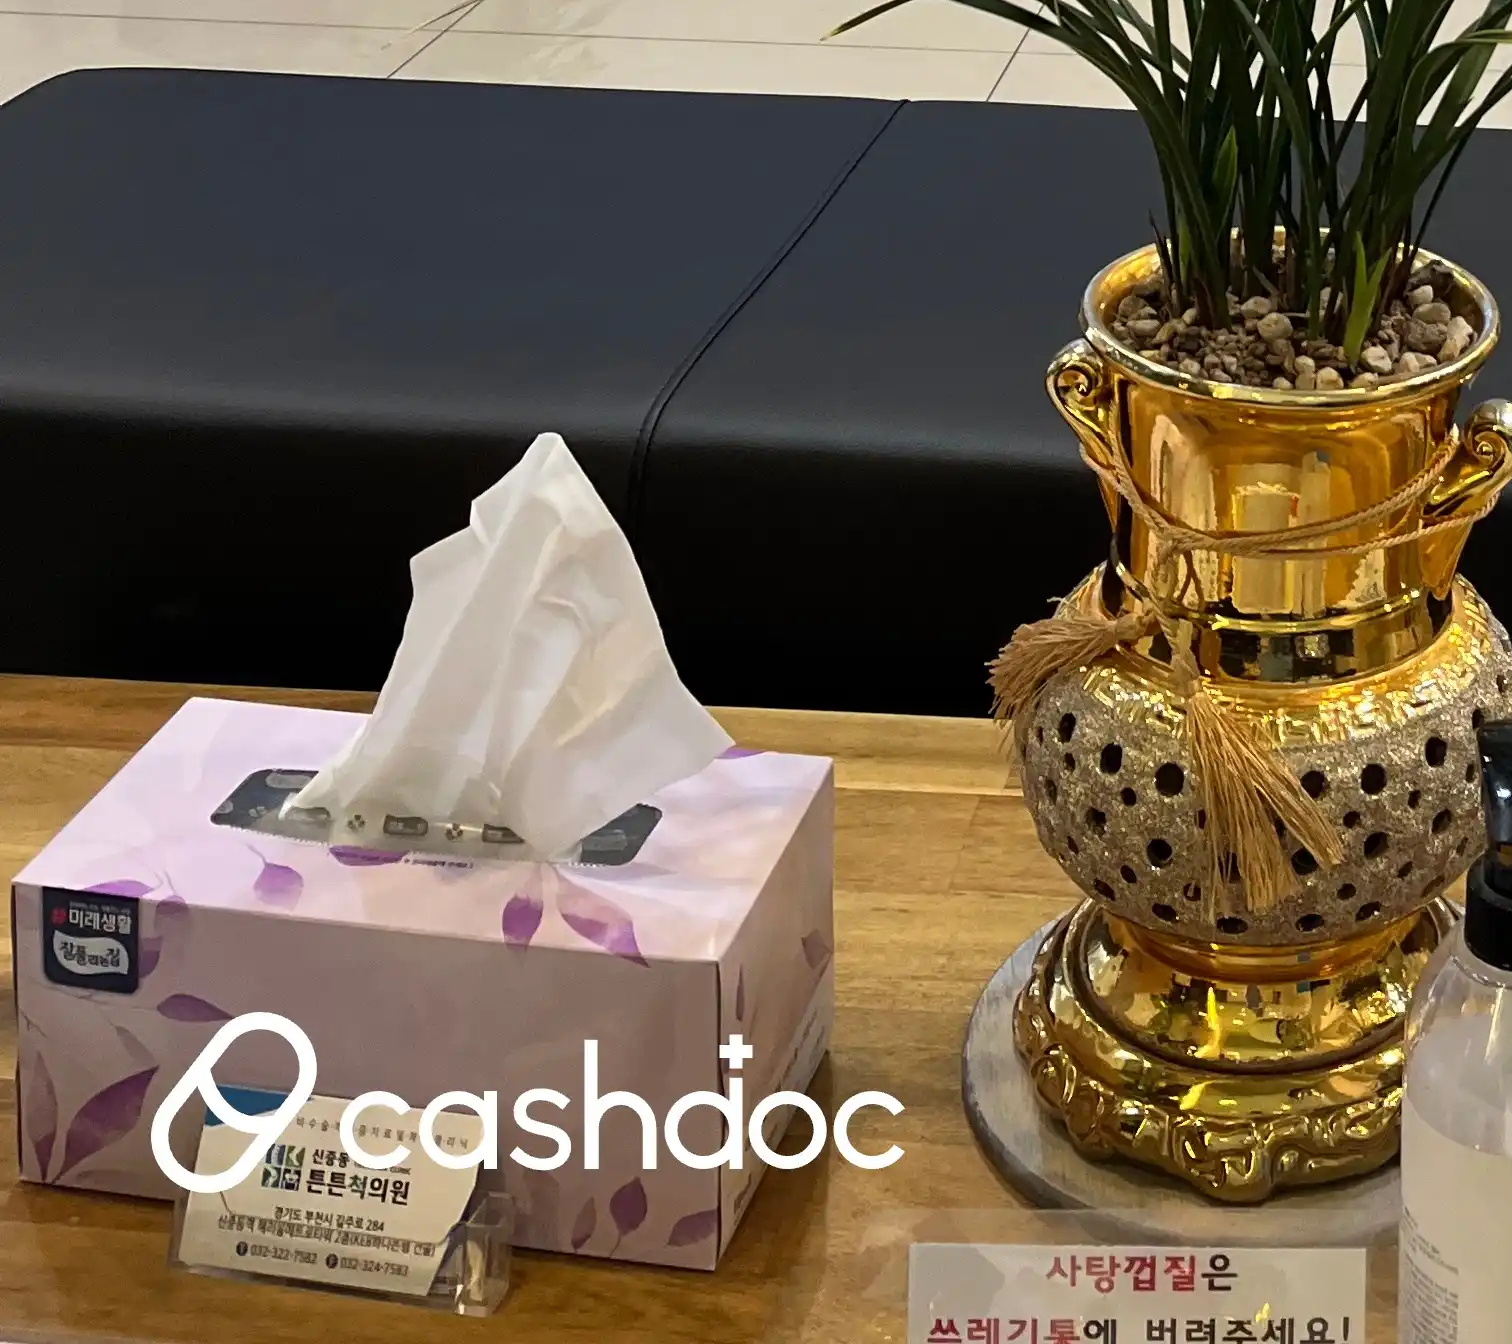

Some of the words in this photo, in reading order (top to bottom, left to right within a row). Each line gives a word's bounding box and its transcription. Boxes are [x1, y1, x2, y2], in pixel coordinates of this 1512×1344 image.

[69, 909, 131, 934] 미래생활
[312, 1148, 348, 1168] 신중동
[306, 1169, 410, 1205] 튼튼척의원
[275, 1207, 302, 1221] 경기도
[305, 1212, 333, 1226] 부천시
[367, 1220, 384, 1231] 284
[1046, 1255, 1237, 1292] 사탕껍질은
[927, 1317, 1117, 1344] 쓰레기통에
[1146, 1317, 1350, 1344] 버려주세요!
